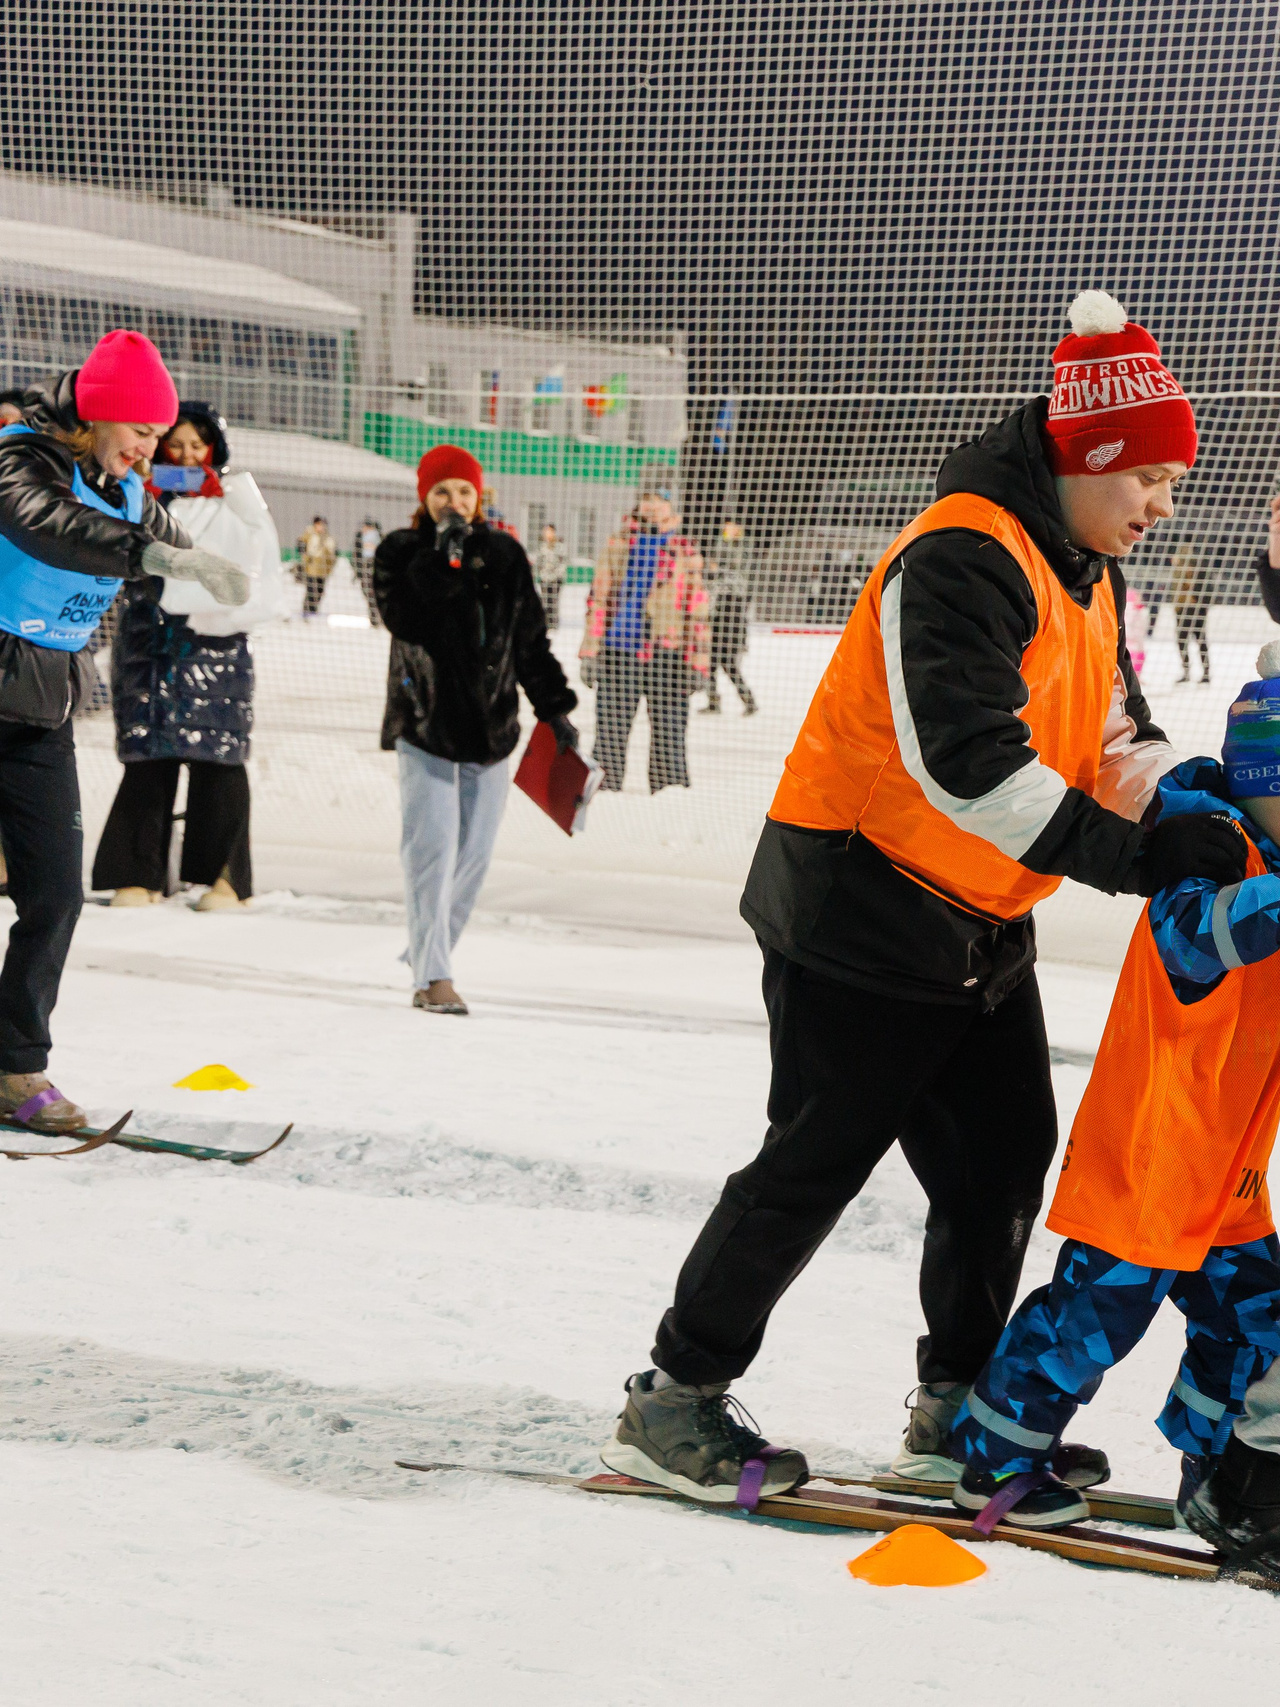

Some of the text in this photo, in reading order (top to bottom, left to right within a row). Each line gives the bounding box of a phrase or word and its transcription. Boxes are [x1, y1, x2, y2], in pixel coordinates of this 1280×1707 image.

[1060, 358, 1151, 381] DETROIT
[65, 592, 113, 608] ЛЫЖ
[58, 606, 101, 623] РОСС
